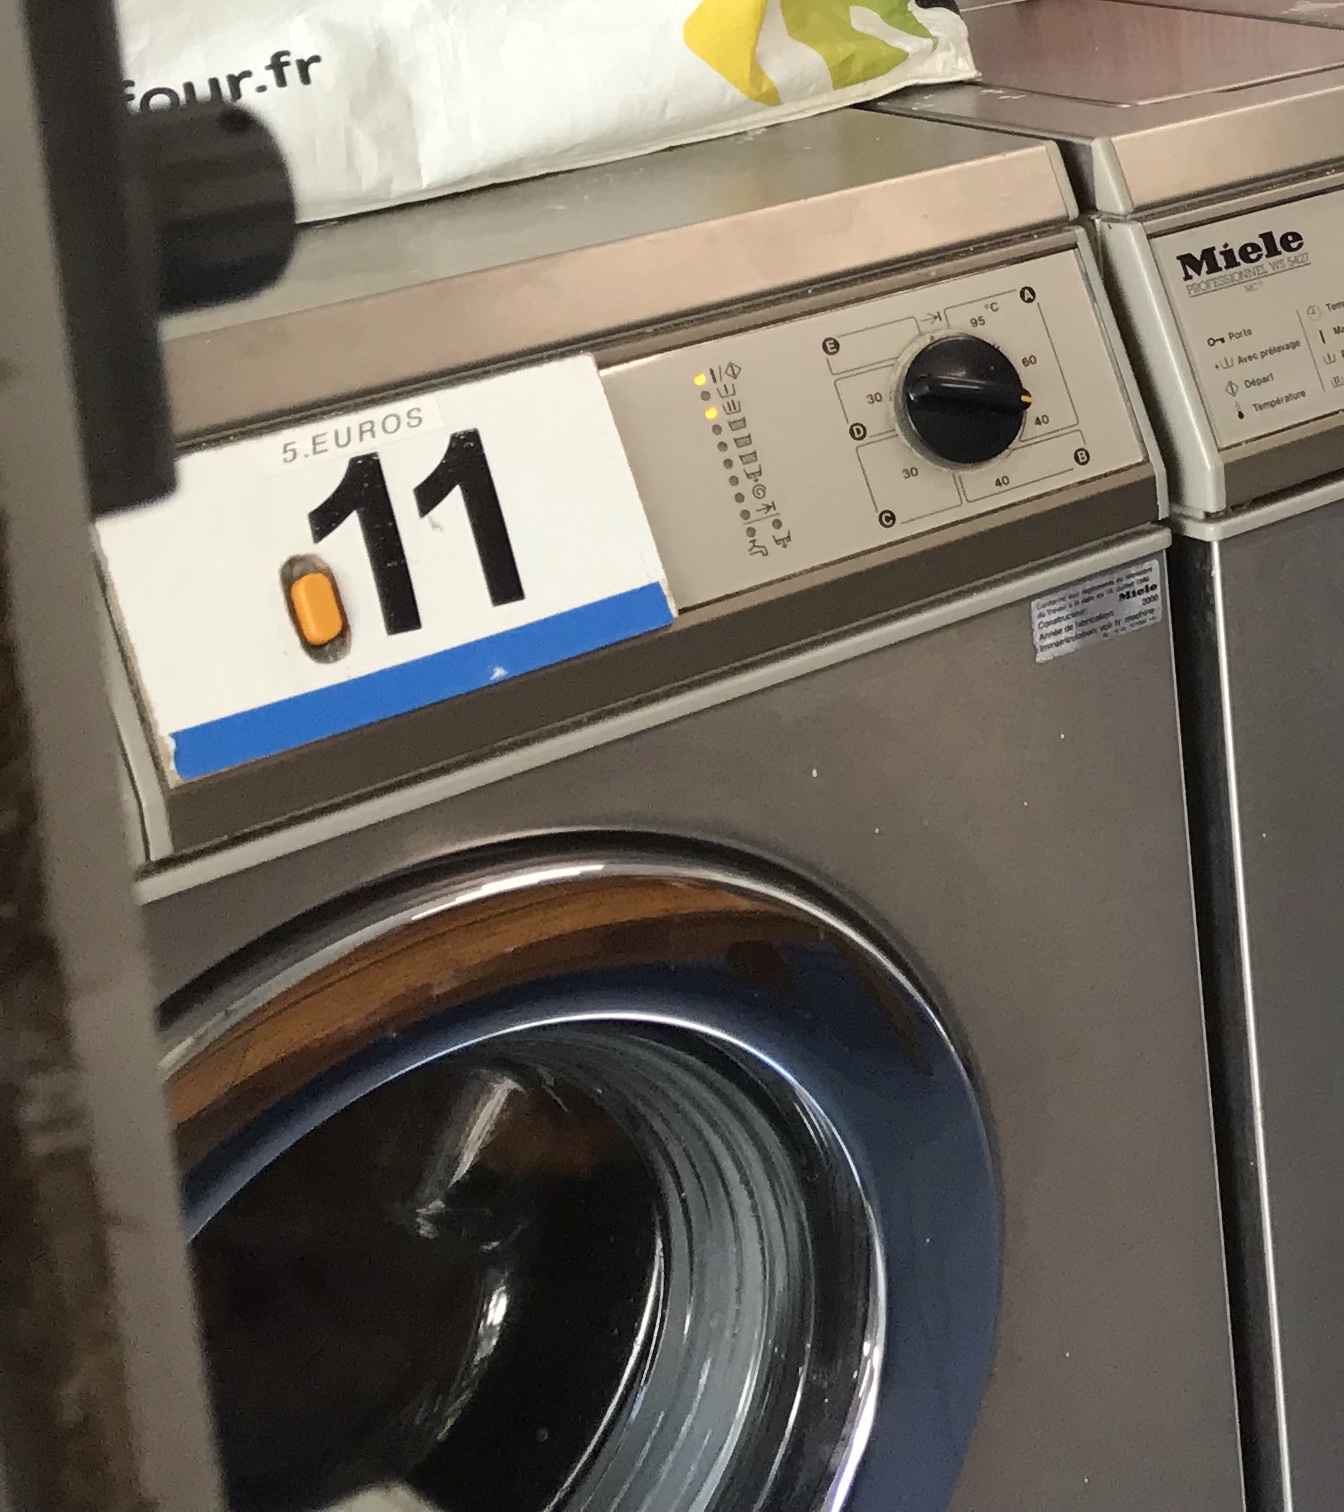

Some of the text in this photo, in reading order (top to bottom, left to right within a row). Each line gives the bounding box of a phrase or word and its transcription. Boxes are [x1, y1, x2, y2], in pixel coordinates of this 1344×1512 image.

[1176, 231, 1304, 281] Miele
[1186, 265, 1269, 296] PROFESSIONNEL
[1271, 260, 1285, 271] WS
[970, 316, 985, 328] 95
[1022, 355, 1036, 367] 60
[281, 406, 424, 464] 5.EUROS
[1035, 415, 1049, 426] 40
[308, 425, 525, 635] 11
